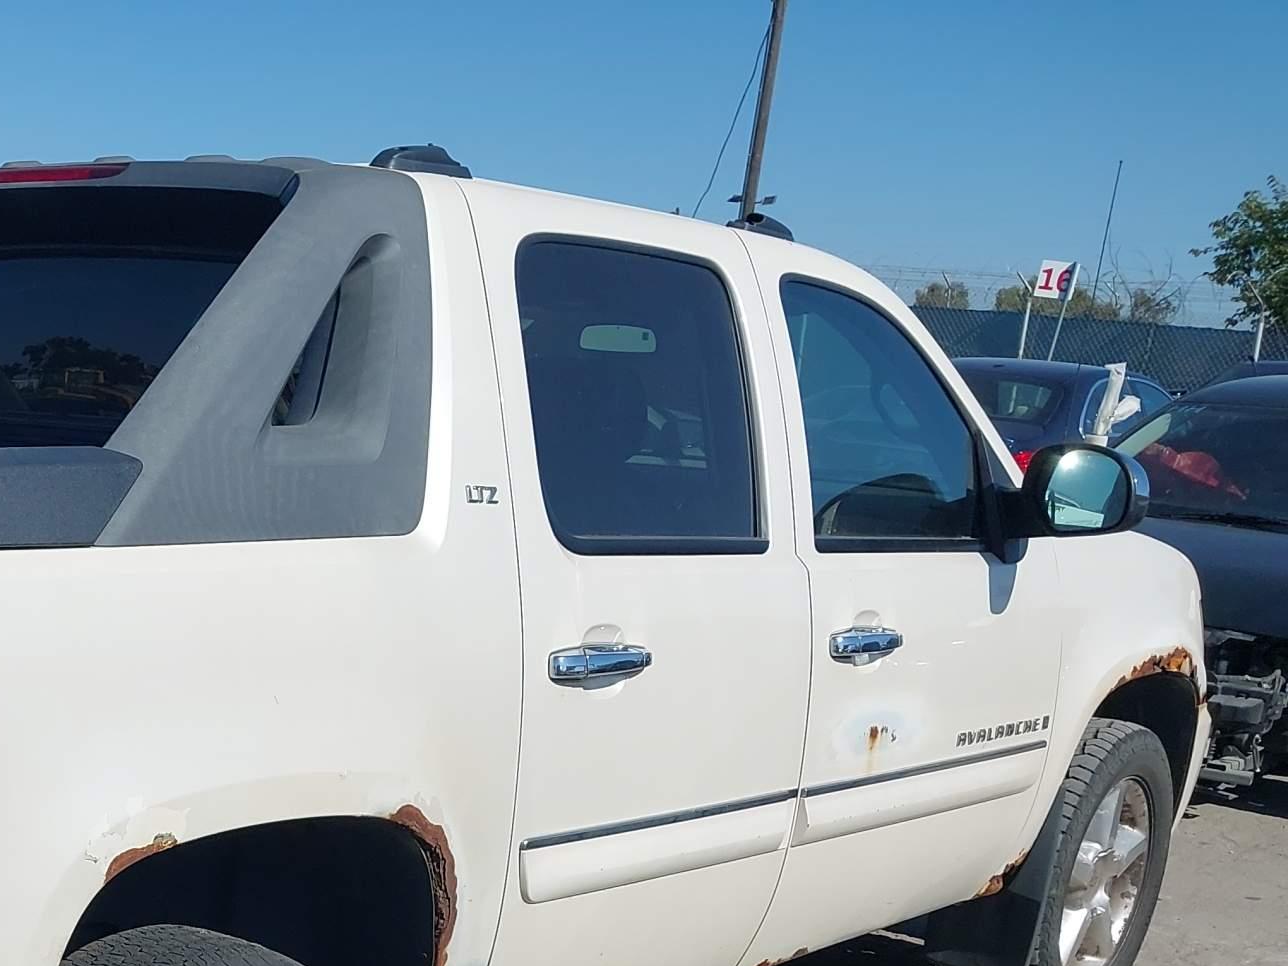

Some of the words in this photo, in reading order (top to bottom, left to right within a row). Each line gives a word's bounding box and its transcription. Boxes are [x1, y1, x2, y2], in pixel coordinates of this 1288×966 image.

[1038, 267, 1071, 292] 16
[465, 484, 499, 504] LTZ
[955, 718, 1041, 747] AVALANCHE
